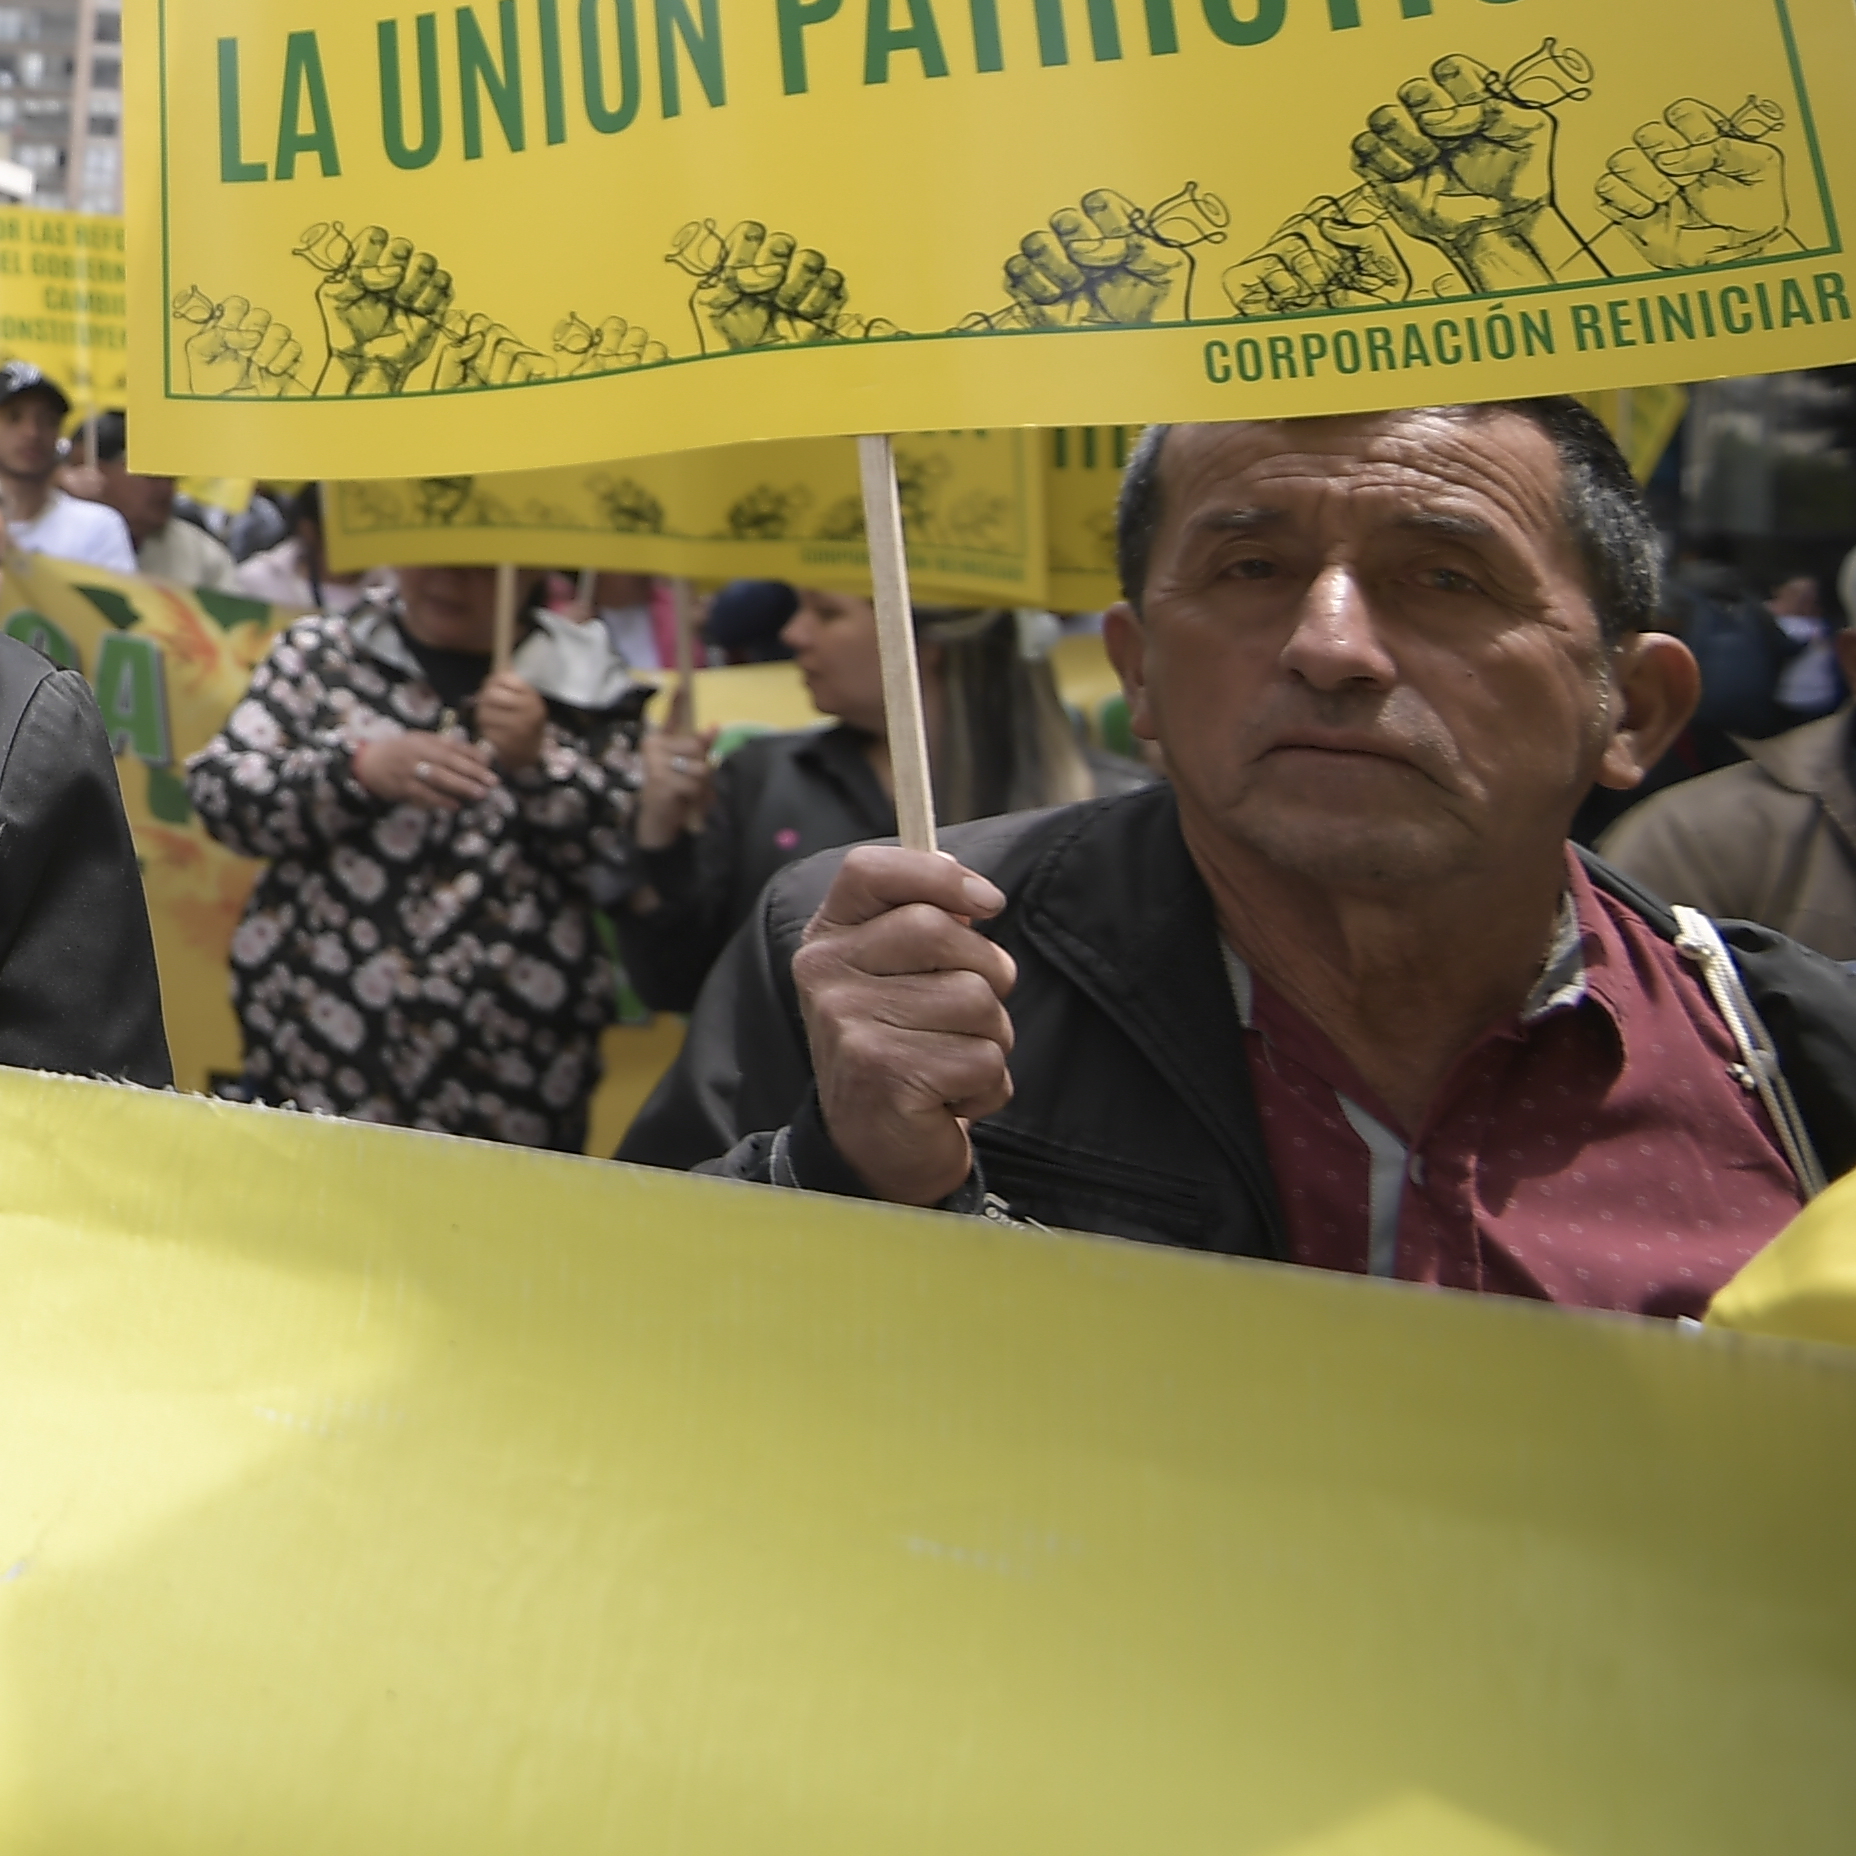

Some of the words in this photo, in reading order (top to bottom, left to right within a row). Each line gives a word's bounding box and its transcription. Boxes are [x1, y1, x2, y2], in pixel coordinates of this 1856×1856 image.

[217, 28, 342, 184] LA
[1203, 302, 1558, 386] CORPORACIÓN
[1572, 268, 1856, 355] REINICIAR
